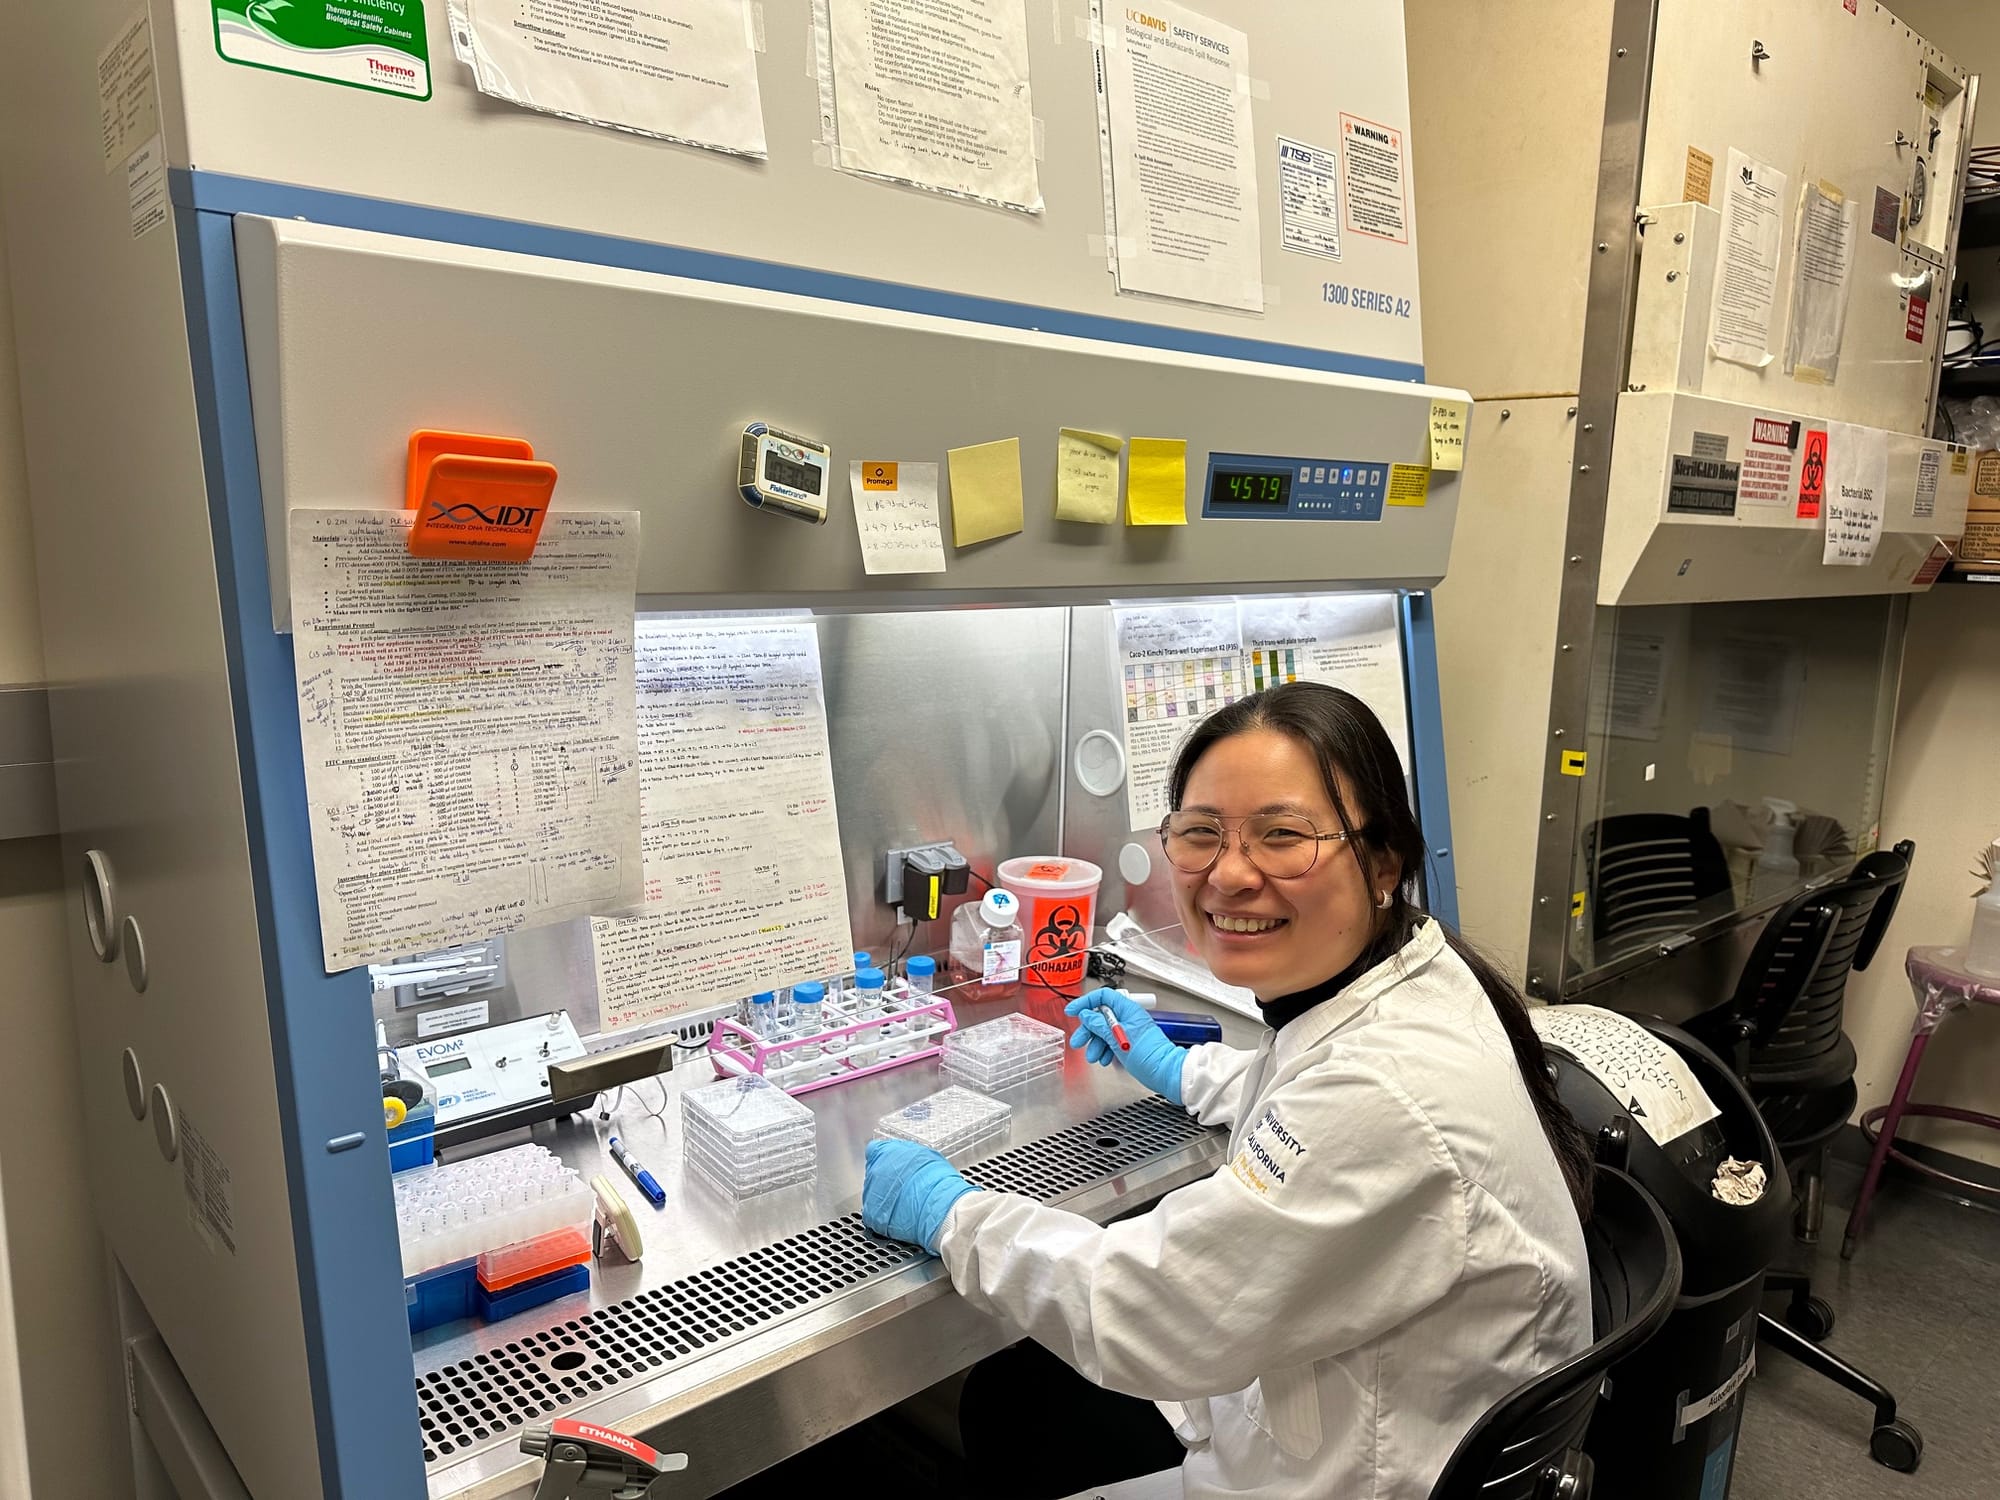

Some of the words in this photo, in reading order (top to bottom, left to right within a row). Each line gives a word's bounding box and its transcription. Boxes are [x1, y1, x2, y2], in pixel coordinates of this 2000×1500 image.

[326, 3, 351, 16] Thermo
[352, 10, 384, 24] Scientific
[326, 12, 360, 26] Biological
[361, 20, 382, 33] Safety
[383, 25, 412, 39] Cabinets
[1125, 24, 1152, 41] Biological
[1153, 33, 1164, 46] and
[1165, 38, 1194, 55] Biohazards
[1195, 48, 1205, 59] Spill
[1206, 52, 1231, 69] Response
[1173, 26, 1198, 44] SAFETY
[1199, 36, 1230, 55] SERVICES
[366, 58, 415, 77] Thermo
[1354, 124, 1389, 144] WARNING
[1322, 282, 1349, 305] 1300
[1351, 287, 1393, 315] SERIES
[1395, 297, 1411, 318] A2
[1755, 420, 1789, 444] WARNING
[866, 478, 893, 486] Promega
[1230, 475, 1281, 500] 4579
[1842, 485, 1863, 499] Bacterial
[495, 506, 543, 527] IDT
[425, 522, 466, 531] INTEGRATED
[485, 526, 533, 534] TECHNOLOGIES
[314, 623, 351, 631] Experimental
[1129, 649, 1146, 658] Caco-2
[1146, 648, 1164, 657] Kimchi
[1164, 646, 1189, 655] Trans-well
[1190, 645, 1218, 655] Experiment
[356, 755, 381, 763] standard
[337, 873, 368, 883] Instructions
[379, 869, 391, 877] plate
[379, 908, 402, 917] procedure
[1032, 959, 1083, 972] BIOHAZARD
[1549, 1032, 1627, 1089] CAUTION
[1595, 1044, 1635, 1081] NEED
[1619, 1039, 1648, 1065] NOT
[1634, 1040, 1662, 1066] FOR
[1648, 1068, 1667, 1090] DO
[1662, 1070, 1687, 1101] NOT
[578, 1425, 637, 1451] ETHANOL
